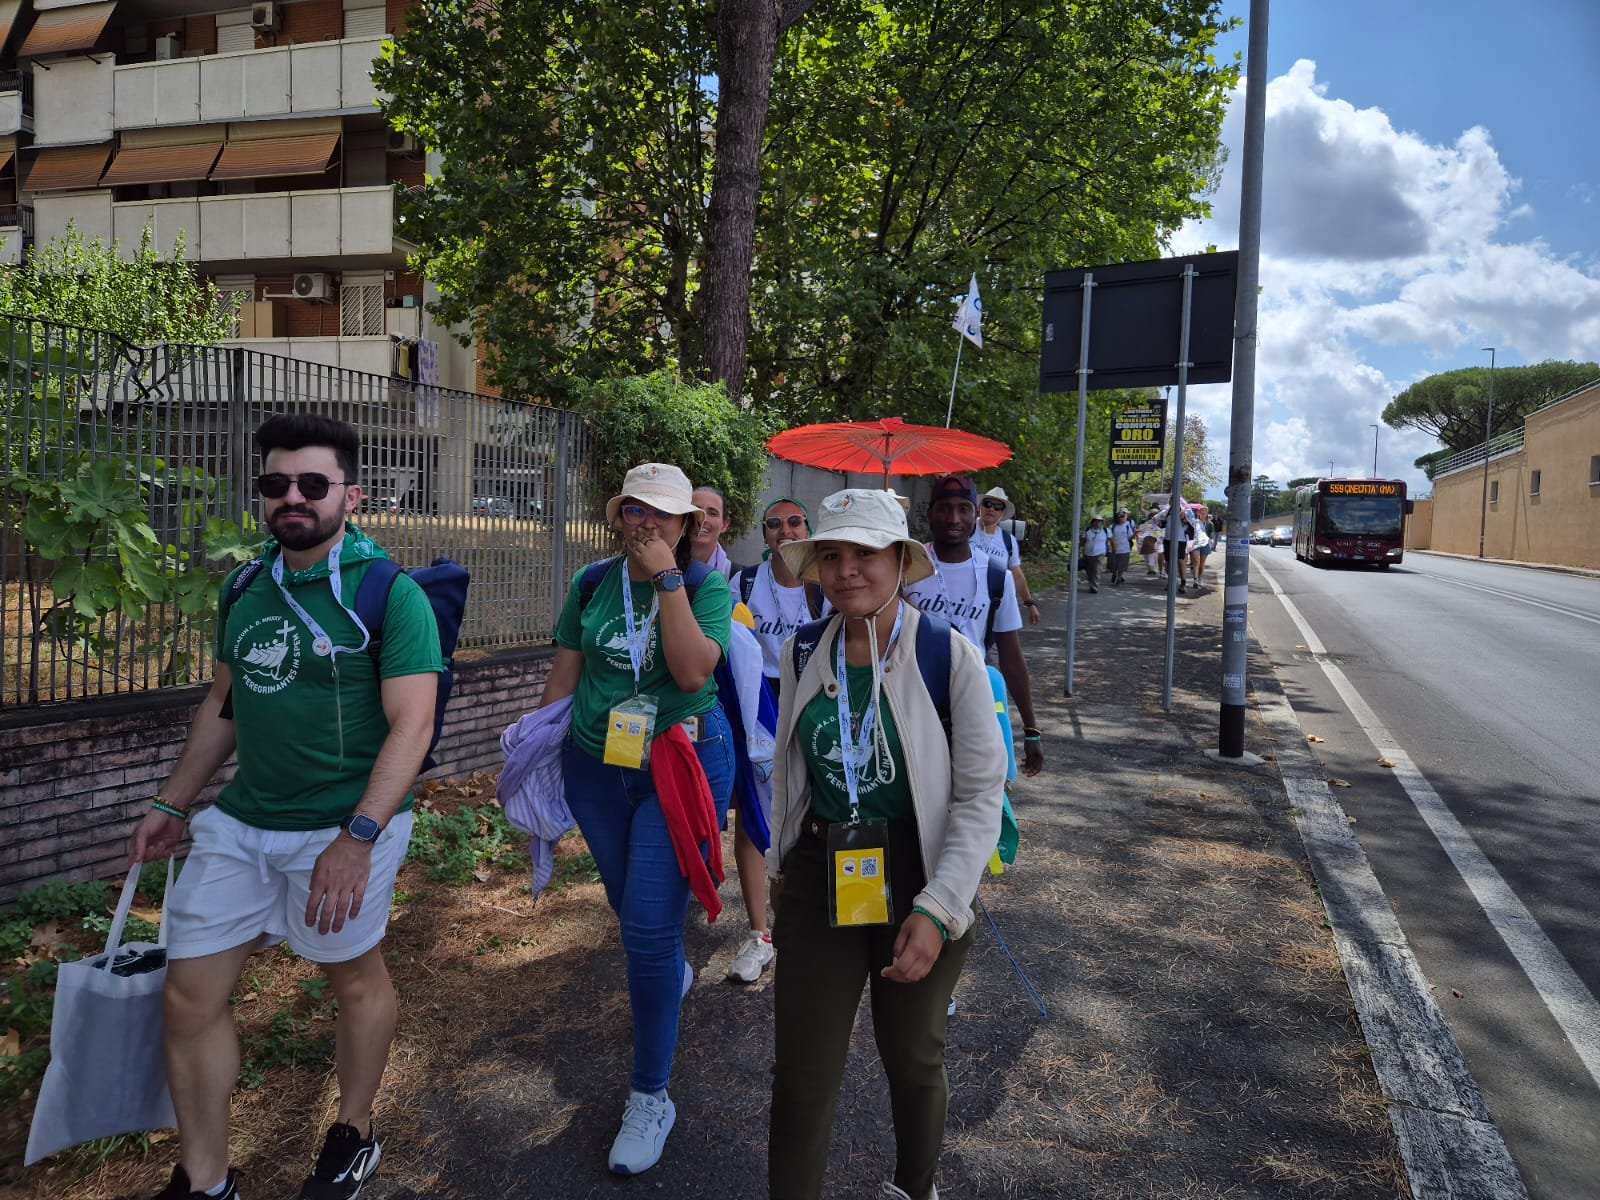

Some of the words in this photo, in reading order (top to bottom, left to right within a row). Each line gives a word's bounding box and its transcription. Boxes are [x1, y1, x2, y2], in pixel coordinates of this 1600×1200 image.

[1121, 429, 1154, 440] ORO
[1329, 484, 1343, 494] 559
[292, 632, 301, 657] SPEM
[292, 658, 300, 669] IN
[242, 668, 298, 694] PEREGRINANTES
